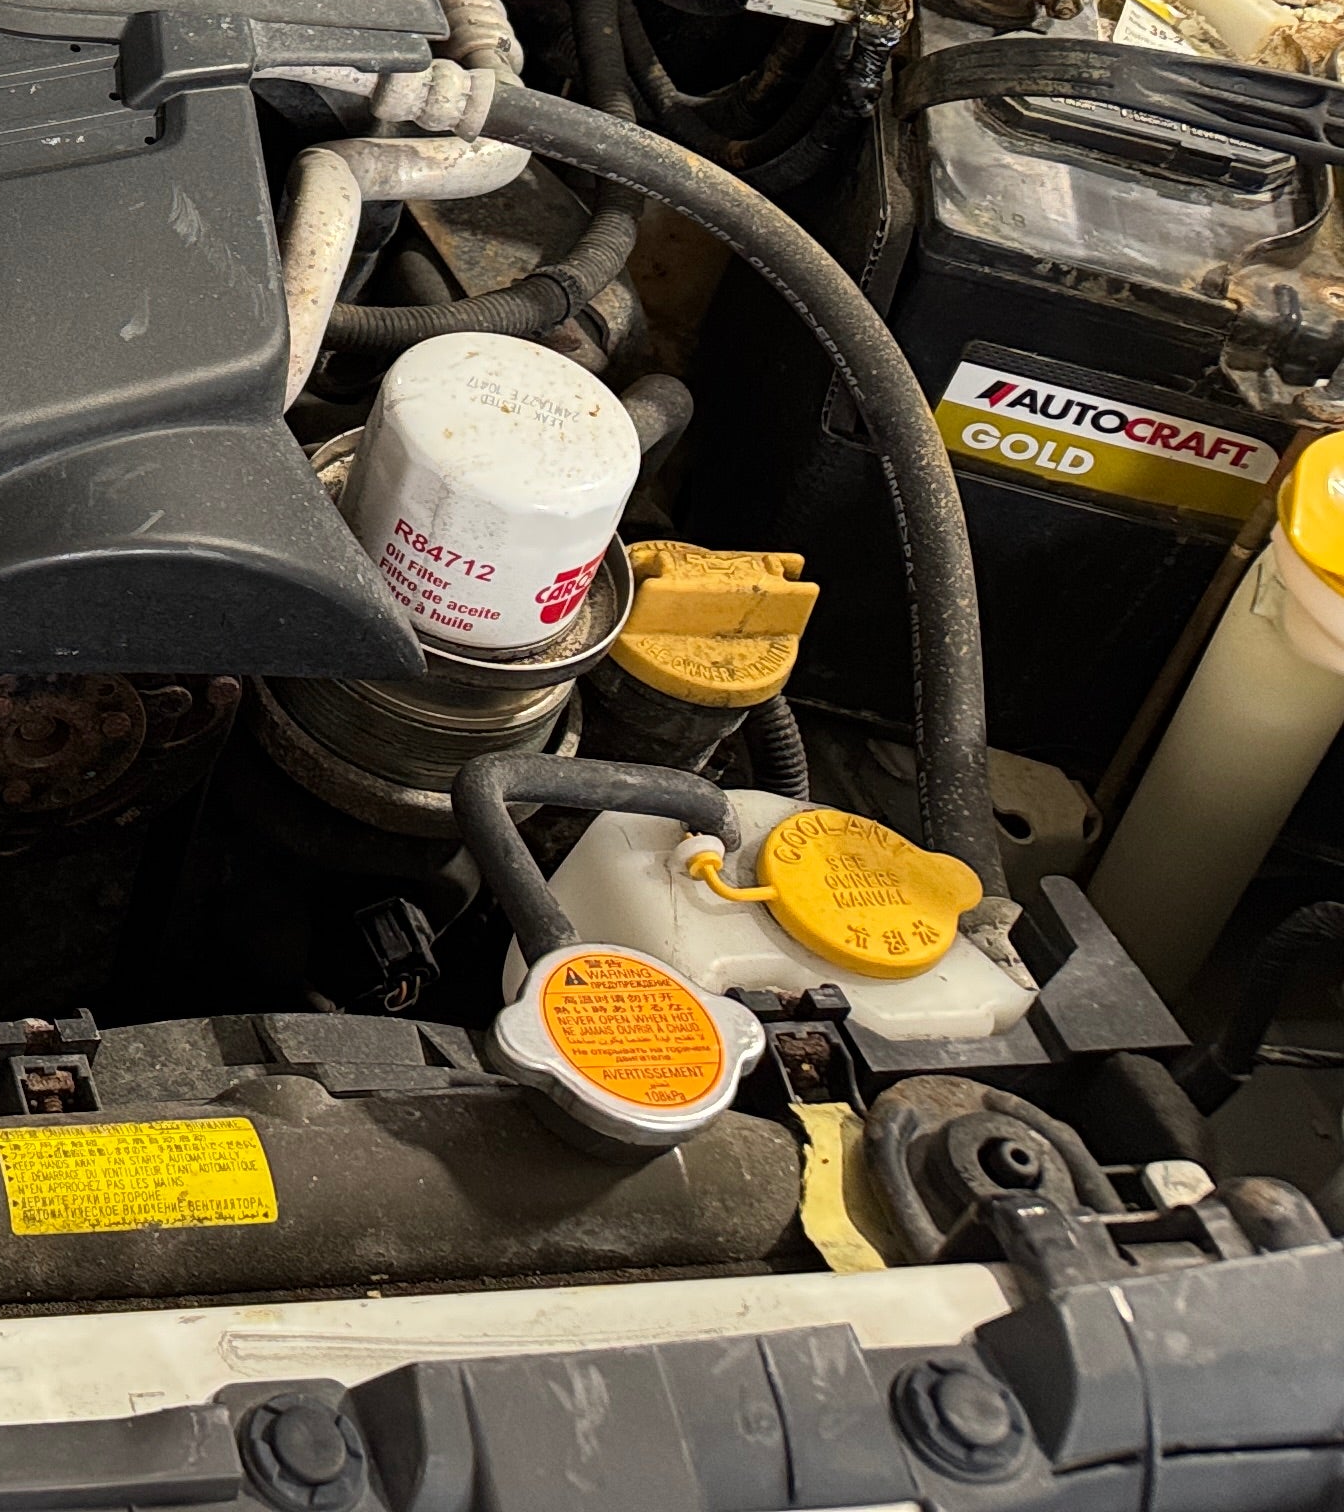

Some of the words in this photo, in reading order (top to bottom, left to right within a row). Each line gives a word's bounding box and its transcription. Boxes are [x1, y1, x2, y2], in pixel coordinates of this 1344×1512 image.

[480, 393, 522, 415] TESTED
[534, 411, 564, 428] LEAK
[1006, 388, 1259, 467] AUTOCRAFT
[962, 422, 1094, 475] GOLD
[394, 519, 496, 582] R84712
[385, 542, 406, 565] Oil
[407, 559, 452, 590] Filter
[379, 556, 419, 593] Filtro
[421, 587, 444, 605] de
[446, 600, 502, 621] aceite
[414, 600, 426, 615] à
[430, 608, 475, 632] huile
[636, 638, 671, 665] SEE
[825, 854, 865, 872] SEE
[824, 870, 900, 889] OWNERS
[832, 888, 914, 909] MANUAL
[584, 968, 653, 980] WARNING
[557, 1016, 595, 1026] NEVER
[598, 1015, 631, 1025] OPEN
[634, 1013, 669, 1024] WHEN
[579, 1025, 616, 1037] JAMAIS
[571, 1048, 589, 1057] Не
[601, 1066, 706, 1081] AVERTISSEMENT
[644, 1089, 687, 1103] 108kPa
[41, 1126, 87, 1139] CAUTION
[13, 1161, 36, 1172] KEEP
[40, 1159, 70, 1169] HANDS
[75, 1157, 97, 1168] AWAY
[107, 1156, 126, 1166] FAN
[128, 1154, 165, 1166] STARTS
[168, 1150, 241, 1164] AUTOMATICALLY
[15, 1172, 27, 1184] LE
[85, 1168, 98, 1180] DU
[102, 1165, 162, 1179] VENTILATEUR
[198, 1159, 259, 1174] AUTOMATIQUE
[47, 1180, 102, 1194] APPROCHEZ
[106, 1178, 126, 1190] PAS
[129, 1177, 150, 1190] LES
[72, 1192, 101, 1207] РУКИ
[112, 1189, 163, 1204] СТОРОНЕ
[122, 1200, 185, 1216] ВКЛЮЧЕНИЕ
